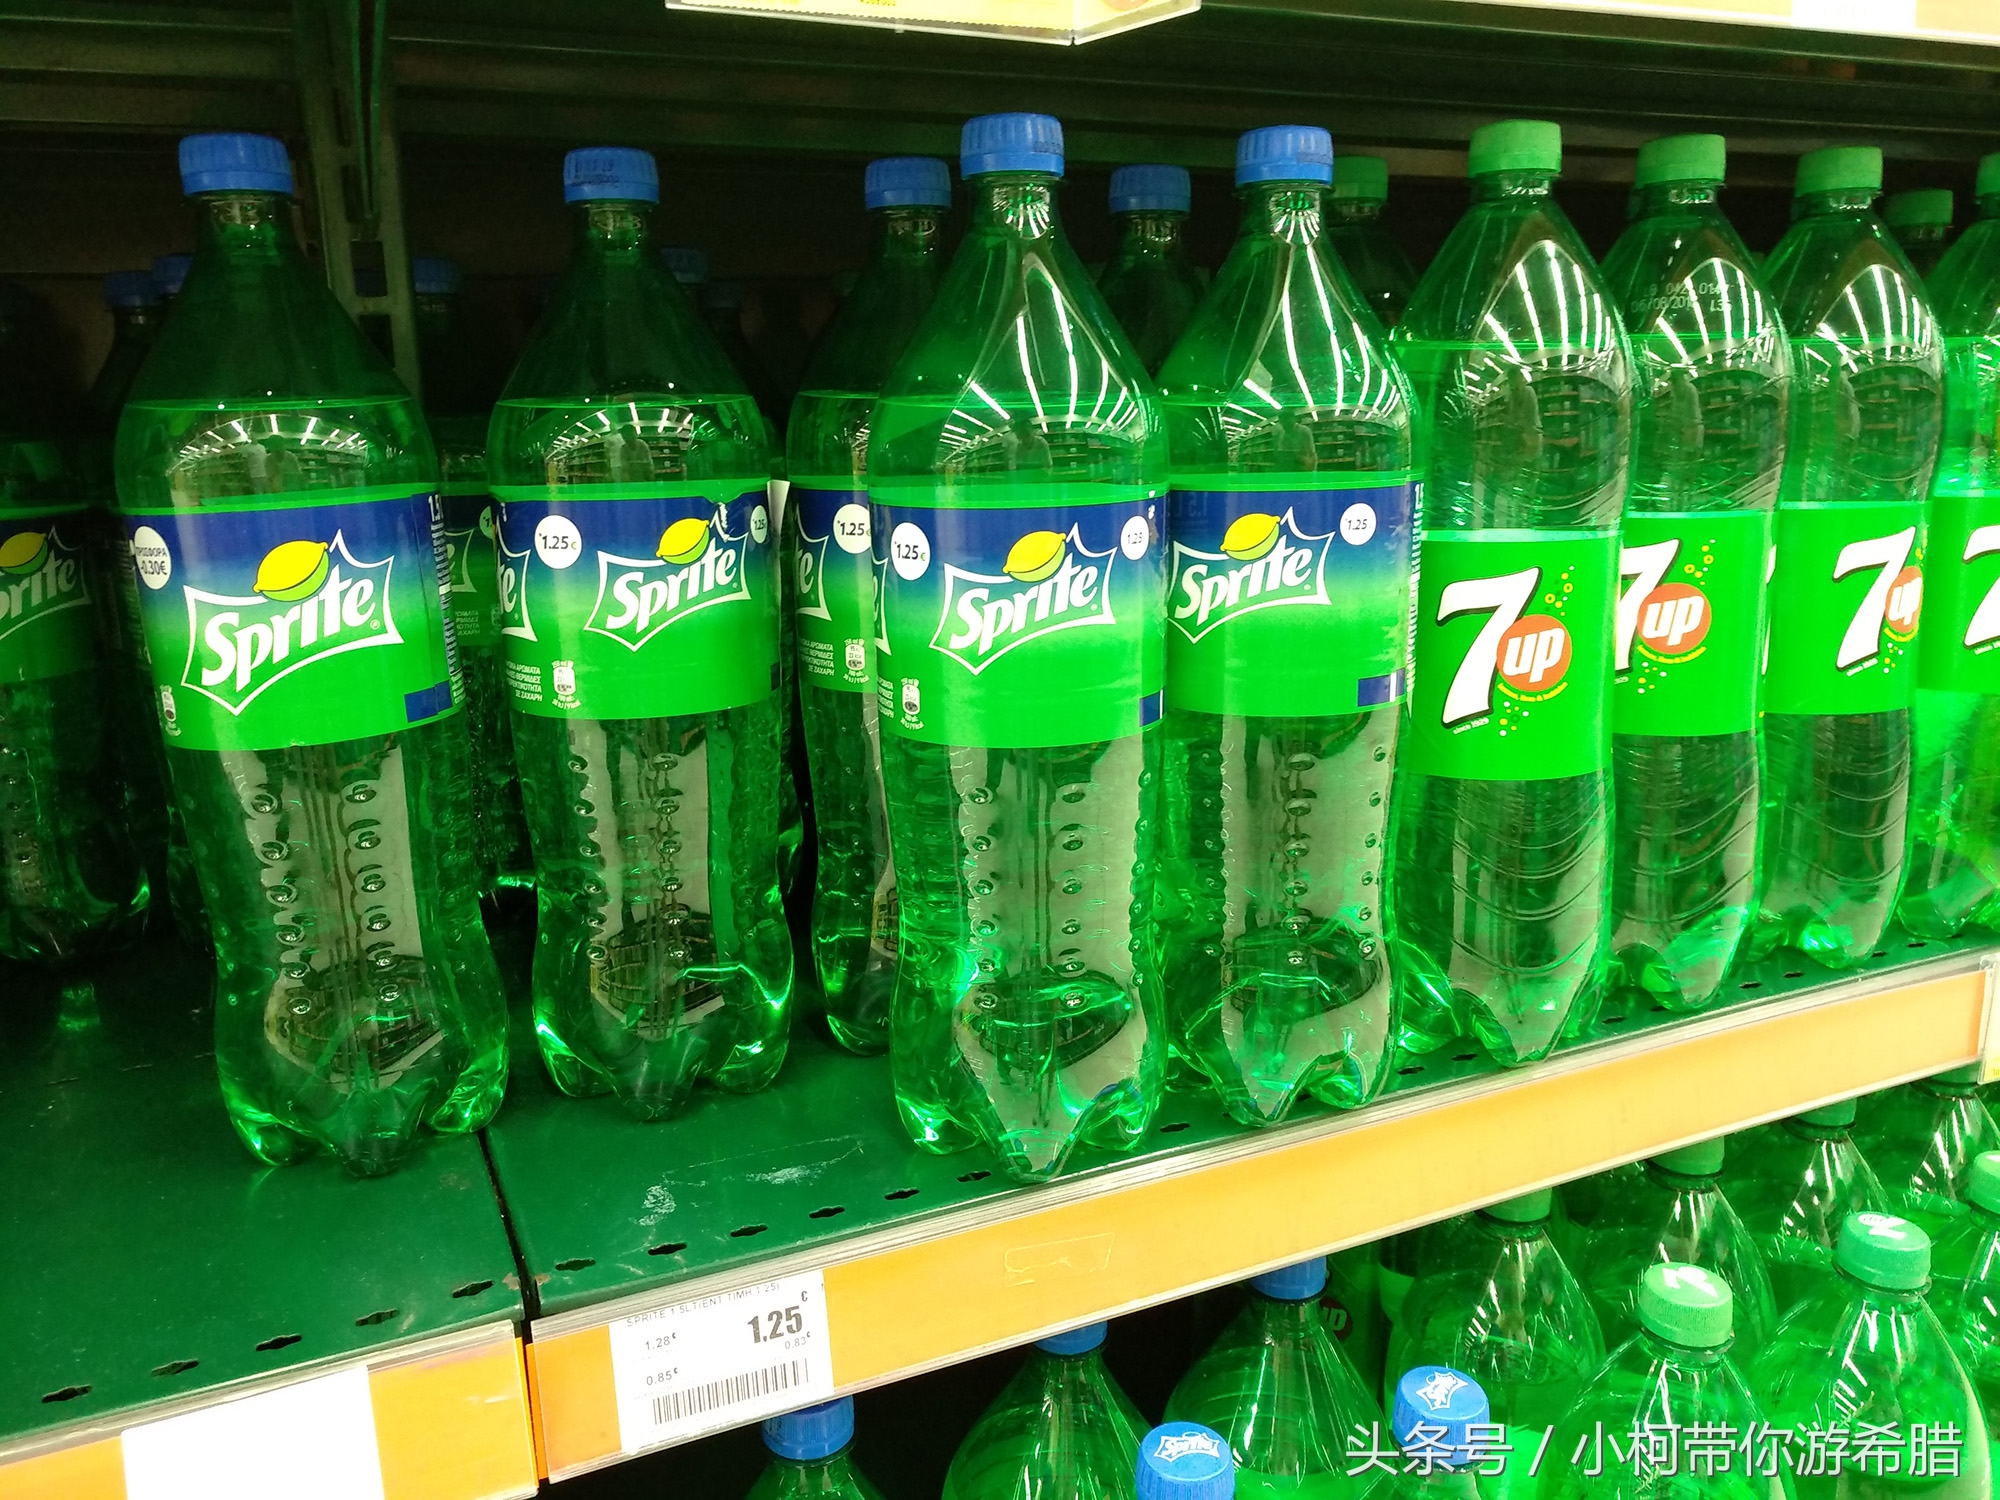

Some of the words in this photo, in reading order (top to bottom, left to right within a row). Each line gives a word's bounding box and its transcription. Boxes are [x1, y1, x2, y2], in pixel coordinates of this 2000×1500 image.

[605, 537, 737, 634] Sprite
[949, 552, 1099, 657] Sprite
[1174, 534, 1313, 627] Sprite
[201, 564, 376, 693] Sprite
[626, 1309, 666, 1327] SPRITE
[747, 1305, 803, 1344] 1.25
